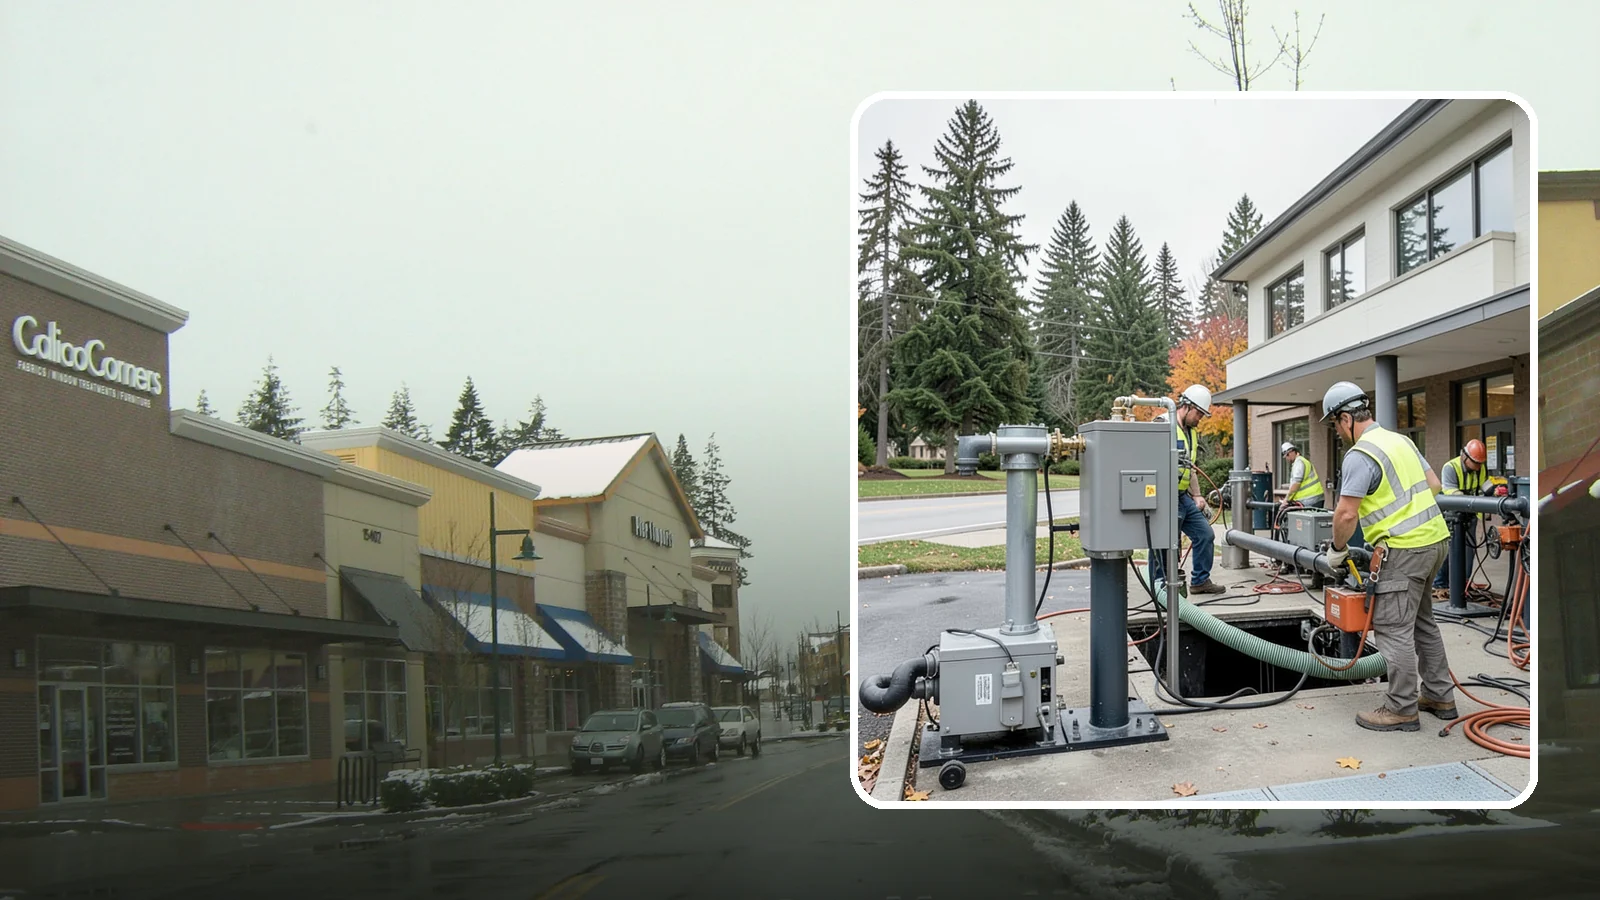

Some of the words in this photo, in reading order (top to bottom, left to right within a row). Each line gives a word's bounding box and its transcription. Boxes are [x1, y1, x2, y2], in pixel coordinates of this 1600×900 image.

[17, 360, 47, 377] FABRICS
[51, 370, 78, 386] WINDOW
[79, 378, 116, 398] TREATMENTS
